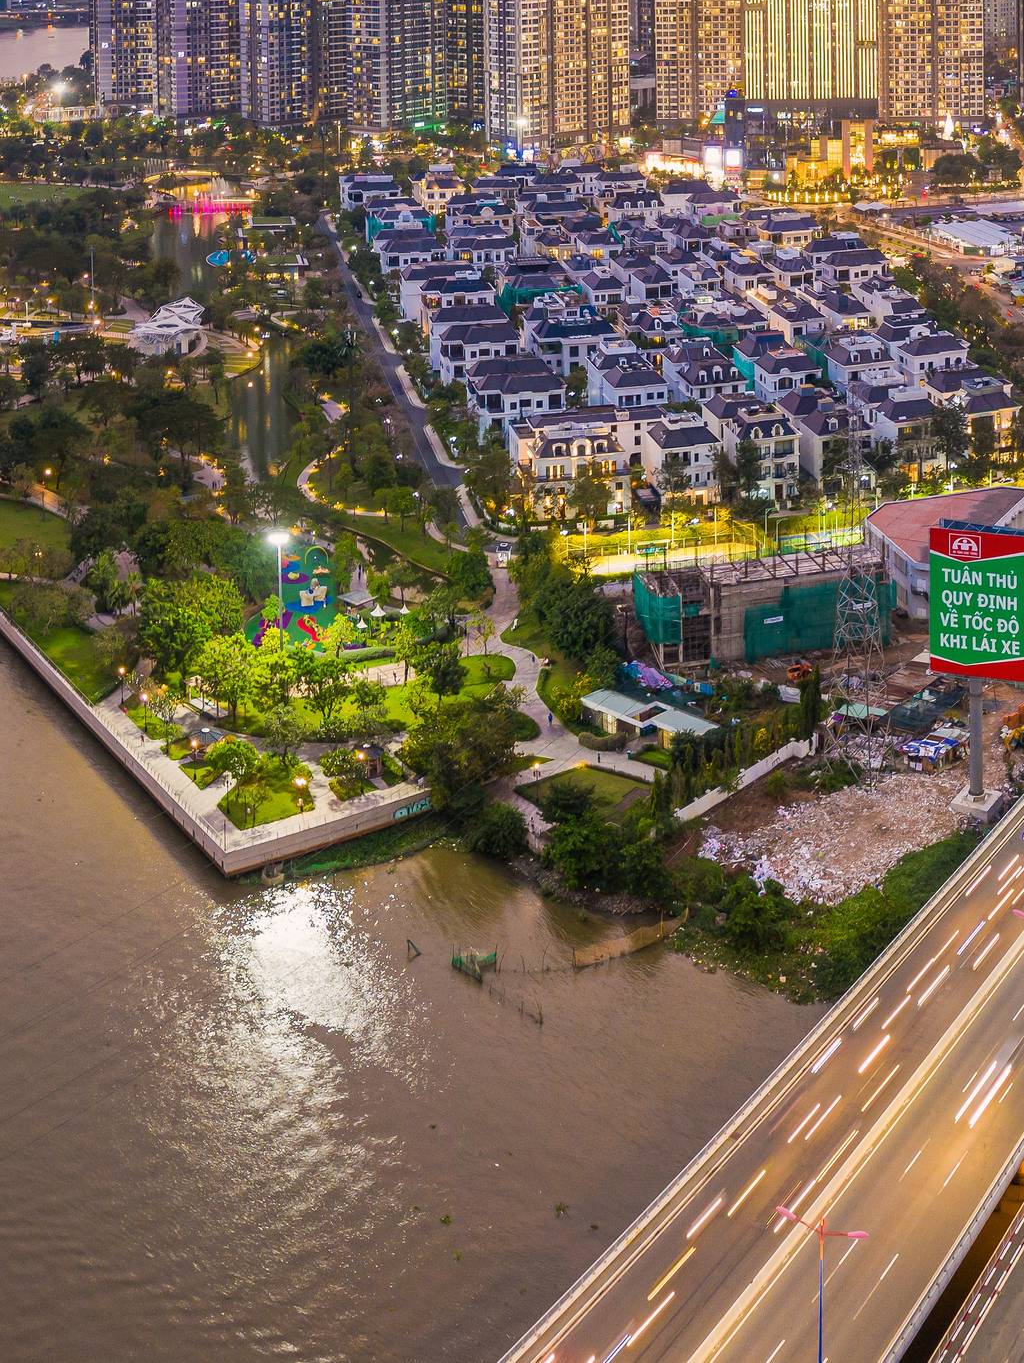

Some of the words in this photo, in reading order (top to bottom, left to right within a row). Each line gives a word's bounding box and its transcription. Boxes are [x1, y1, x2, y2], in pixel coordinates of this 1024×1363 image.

[942, 566, 982, 586] TUÂN
[986, 570, 1017, 589] THỦ
[941, 590, 973, 607] QUY
[977, 593, 1018, 613] ĐỊNH
[940, 608, 959, 628] VỀ
[963, 611, 992, 632] TỐC
[996, 616, 1019, 637] ĐỘ
[940, 633, 967, 650] KHI
[972, 633, 996, 652] LÁI
[1001, 640, 1020, 655] XE
